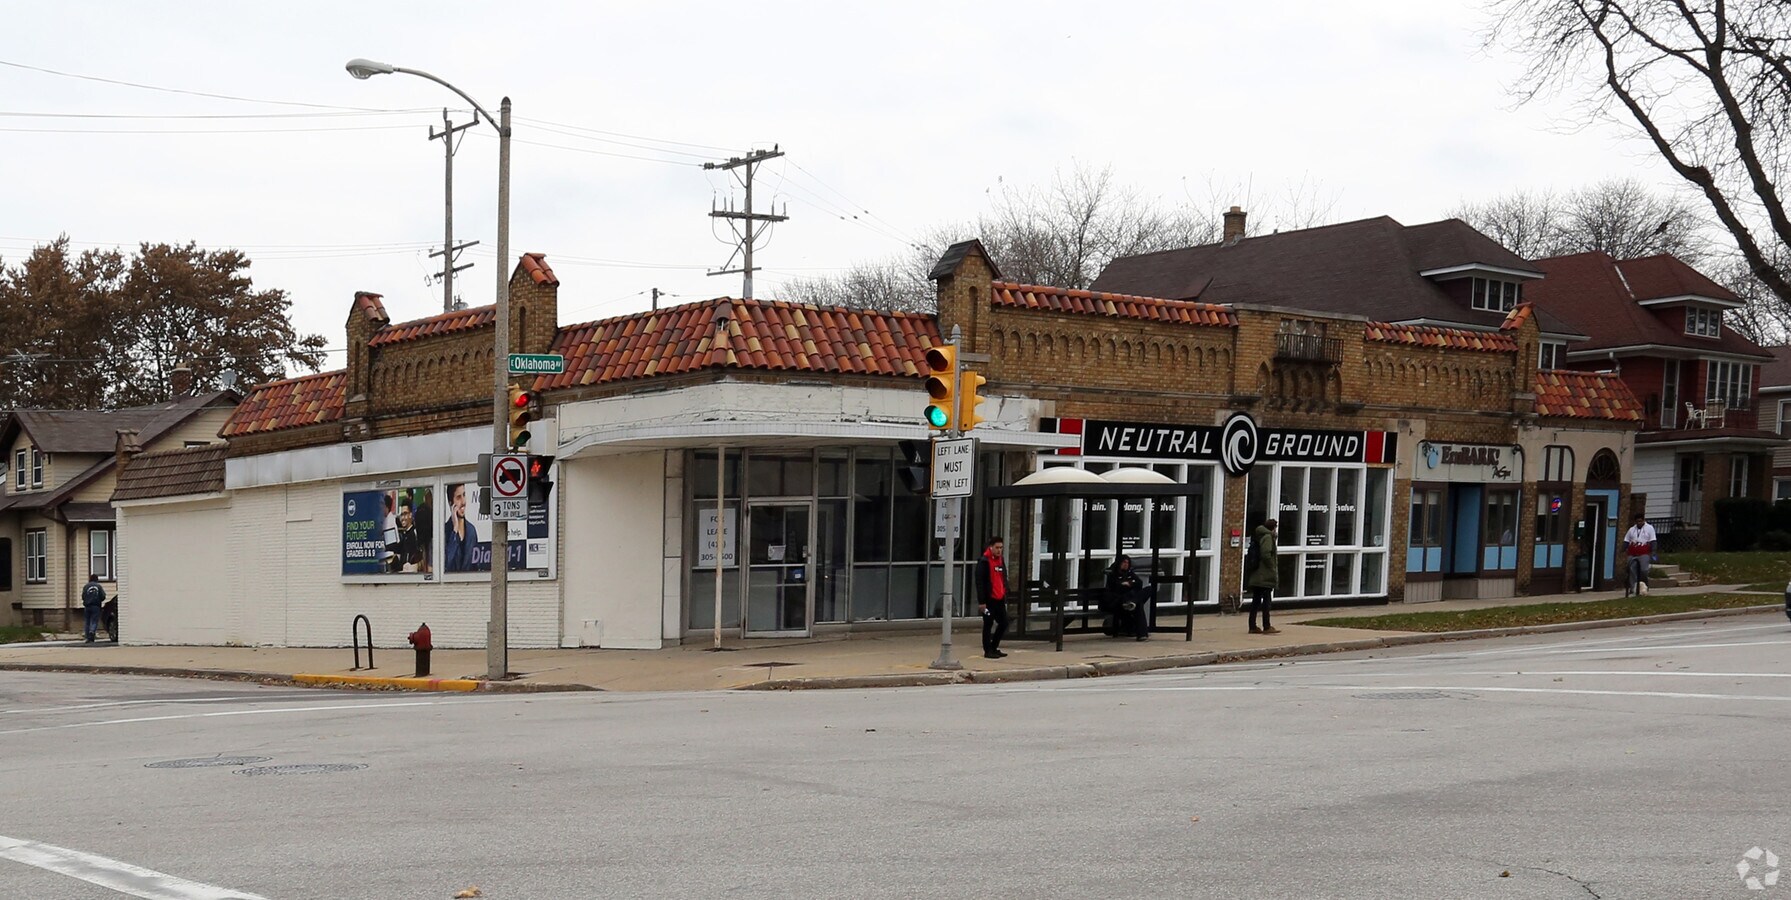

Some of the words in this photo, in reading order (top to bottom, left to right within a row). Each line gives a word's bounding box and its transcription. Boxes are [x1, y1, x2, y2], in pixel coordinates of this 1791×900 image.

[510, 359, 514, 367] E
[514, 356, 556, 370] Oklahoma
[1099, 427, 1212, 454] NEUTRAL
[1265, 433, 1359, 457] GROUND
[937, 446, 951, 456] LEFT
[954, 445, 969, 454] LANE
[944, 461, 962, 473] MUST
[936, 480, 951, 490] TURN
[954, 478, 968, 488] LEFT
[494, 504, 501, 516] 3
[503, 501, 520, 509] TONS
[1084, 502, 1106, 511] Tain.
[1280, 503, 1298, 511] Train.
[346, 521, 359, 531] FIND
[359, 520, 375, 530] YOUR
[346, 531, 368, 540] FUTURE
[346, 541, 364, 550] ENROLL
[363, 541, 375, 549] NOW
[375, 540, 385, 549] FOR
[346, 550, 364, 558] GRADES
[372, 549, 376, 557] 9
[471, 546, 491, 564] Dia
